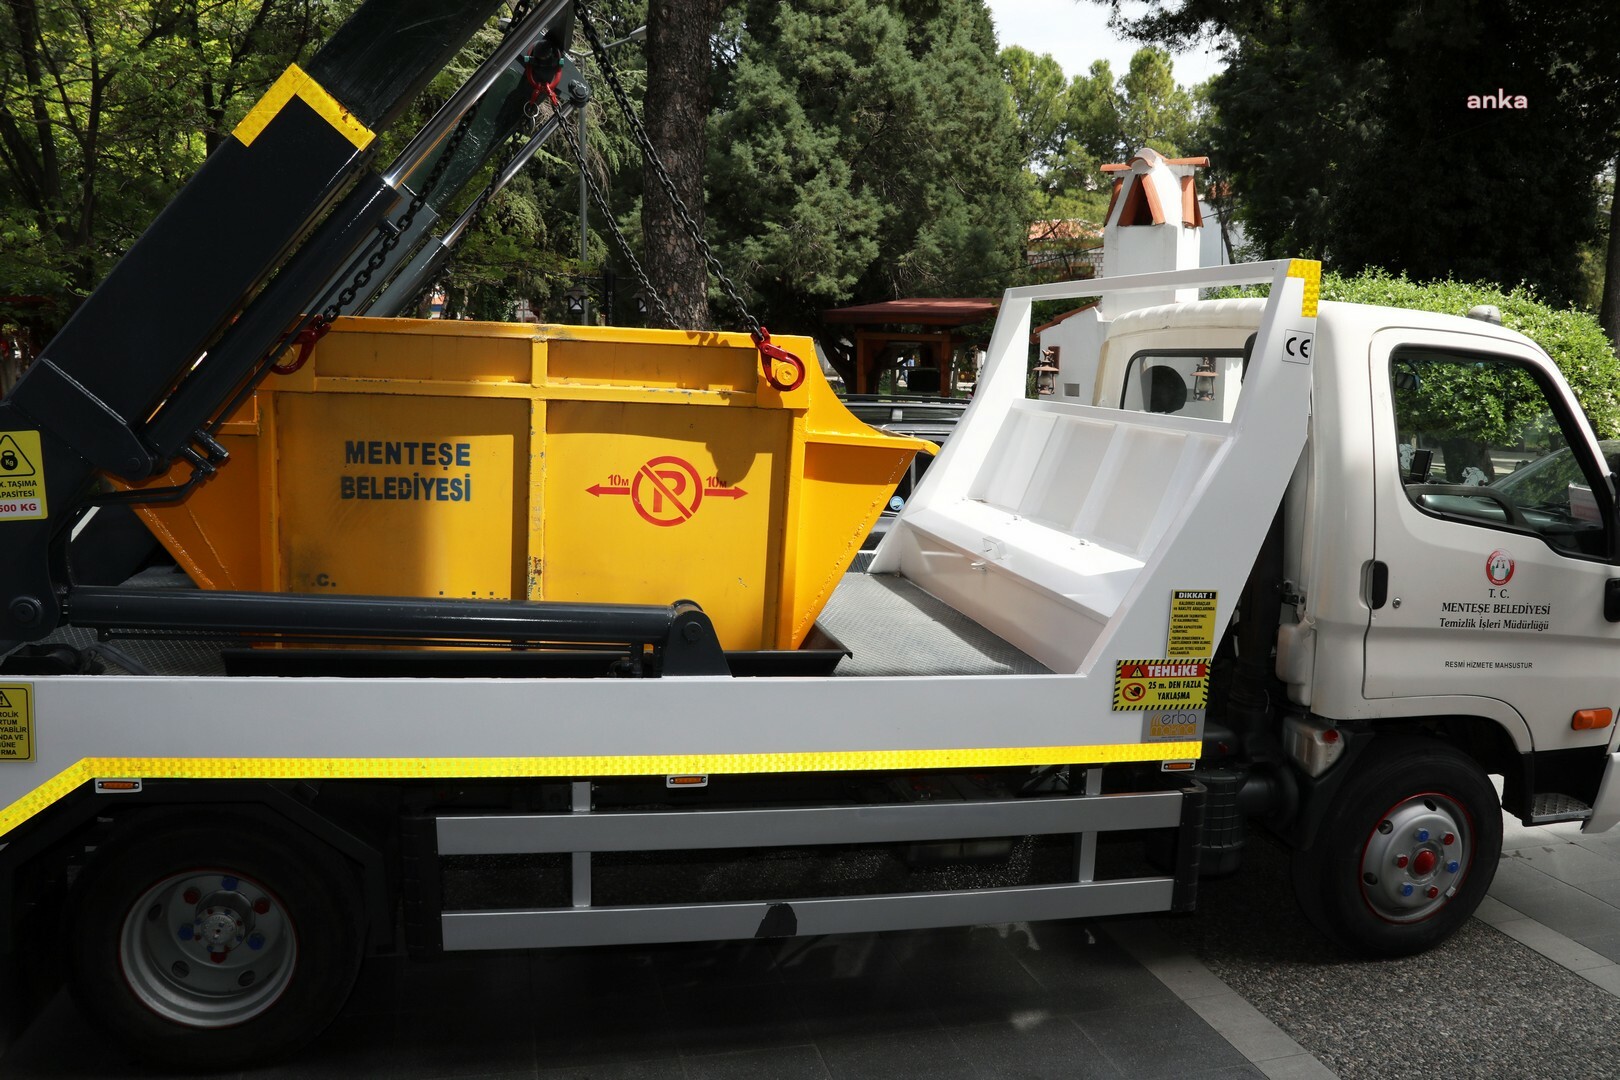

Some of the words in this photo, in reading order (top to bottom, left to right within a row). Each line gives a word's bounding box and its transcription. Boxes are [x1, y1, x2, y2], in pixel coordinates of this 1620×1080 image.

[1286, 337, 1310, 358] CE
[345, 440, 471, 471] MENTEŞE
[7, 480, 37, 489] TAŞIMA
[340, 472, 471, 501] BELEDİYESİ
[0, 488, 35, 498] PASİTESİ
[20, 503, 37, 511] KG
[1441, 602, 1490, 615] MENTEŞE
[1493, 602, 1551, 615] BELEDİYESİ
[1440, 618, 1476, 628] Temizlik
[1479, 616, 1501, 630] İşleri
[1503, 619, 1549, 631] Müdürlüğü
[1148, 681, 1157, 689] 25
[1168, 681, 1181, 689] DEN
[1182, 680, 1201, 688] FAZLA
[1157, 691, 1190, 701] YAKLAŞMA
[1162, 710, 1197, 724] erba
